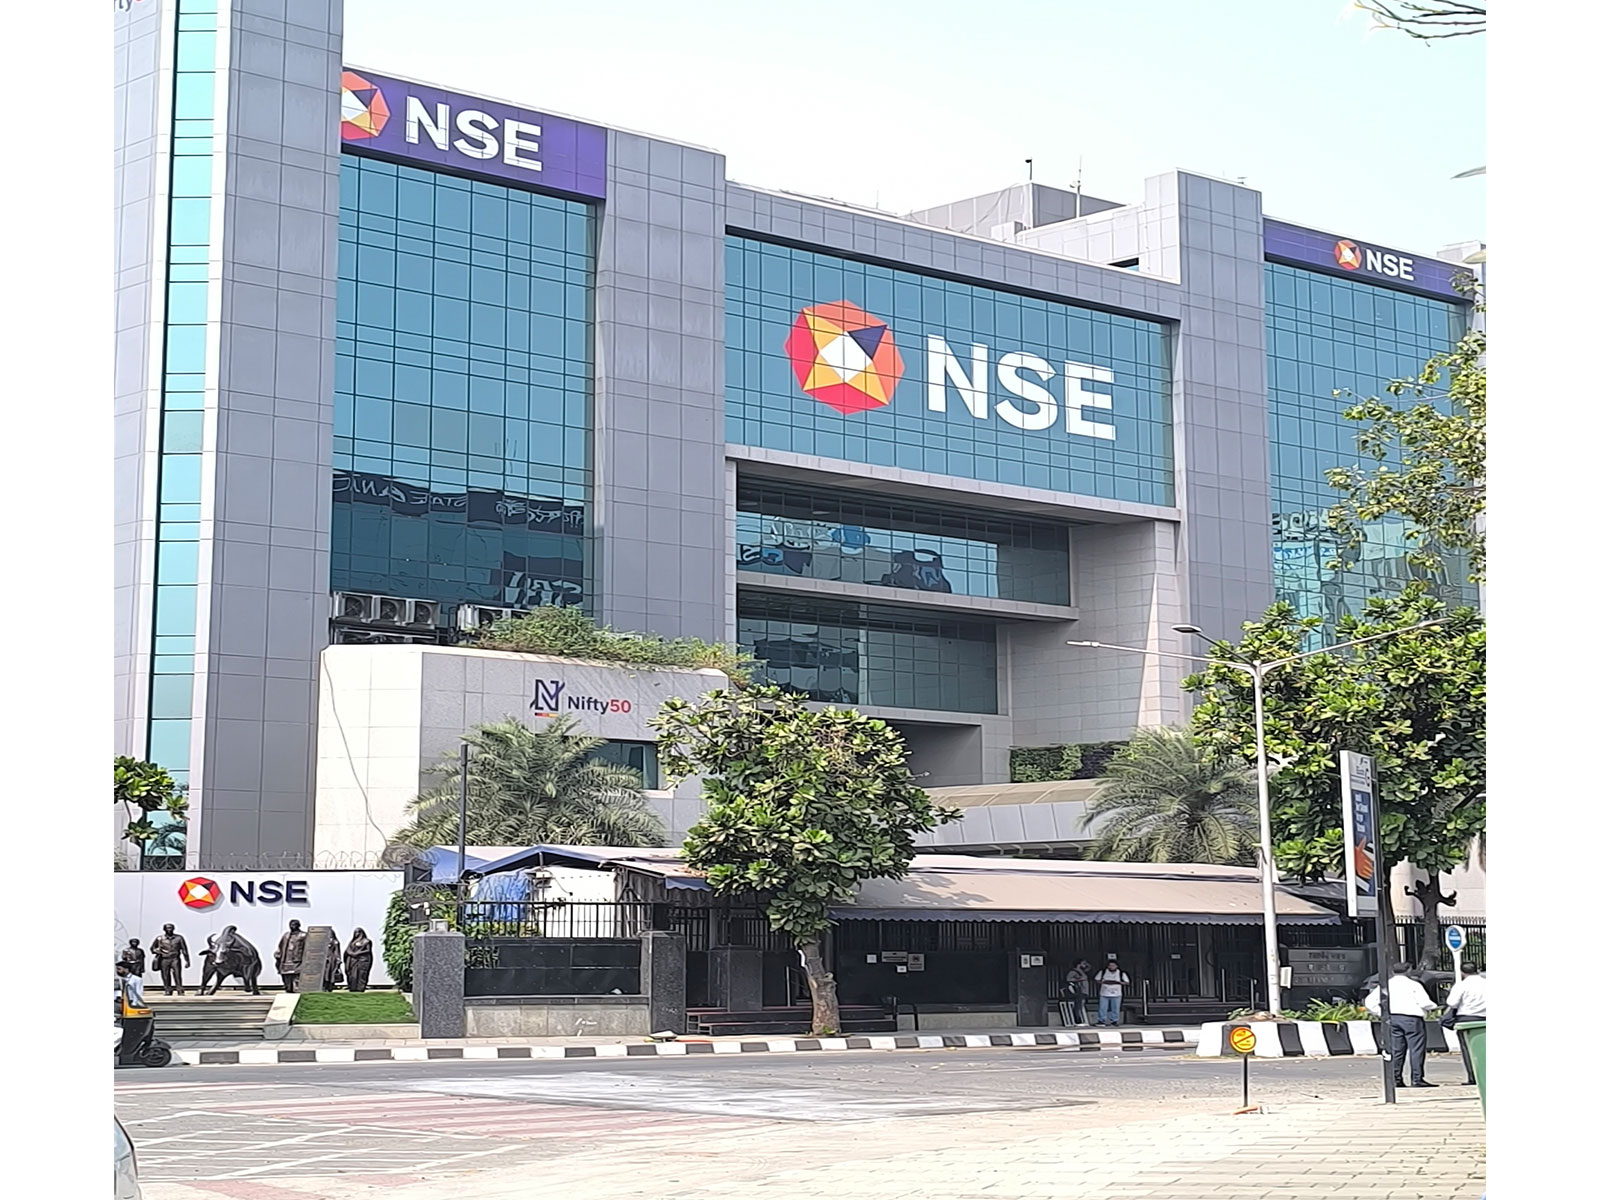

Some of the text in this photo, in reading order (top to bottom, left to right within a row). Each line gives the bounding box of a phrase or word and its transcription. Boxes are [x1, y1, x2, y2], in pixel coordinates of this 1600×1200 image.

[405, 95, 543, 172] NSE
[1365, 248, 1415, 281] NSE
[927, 333, 1117, 441] NSE
[567, 696, 632, 715] Nifty50
[229, 880, 308, 904] NSE
